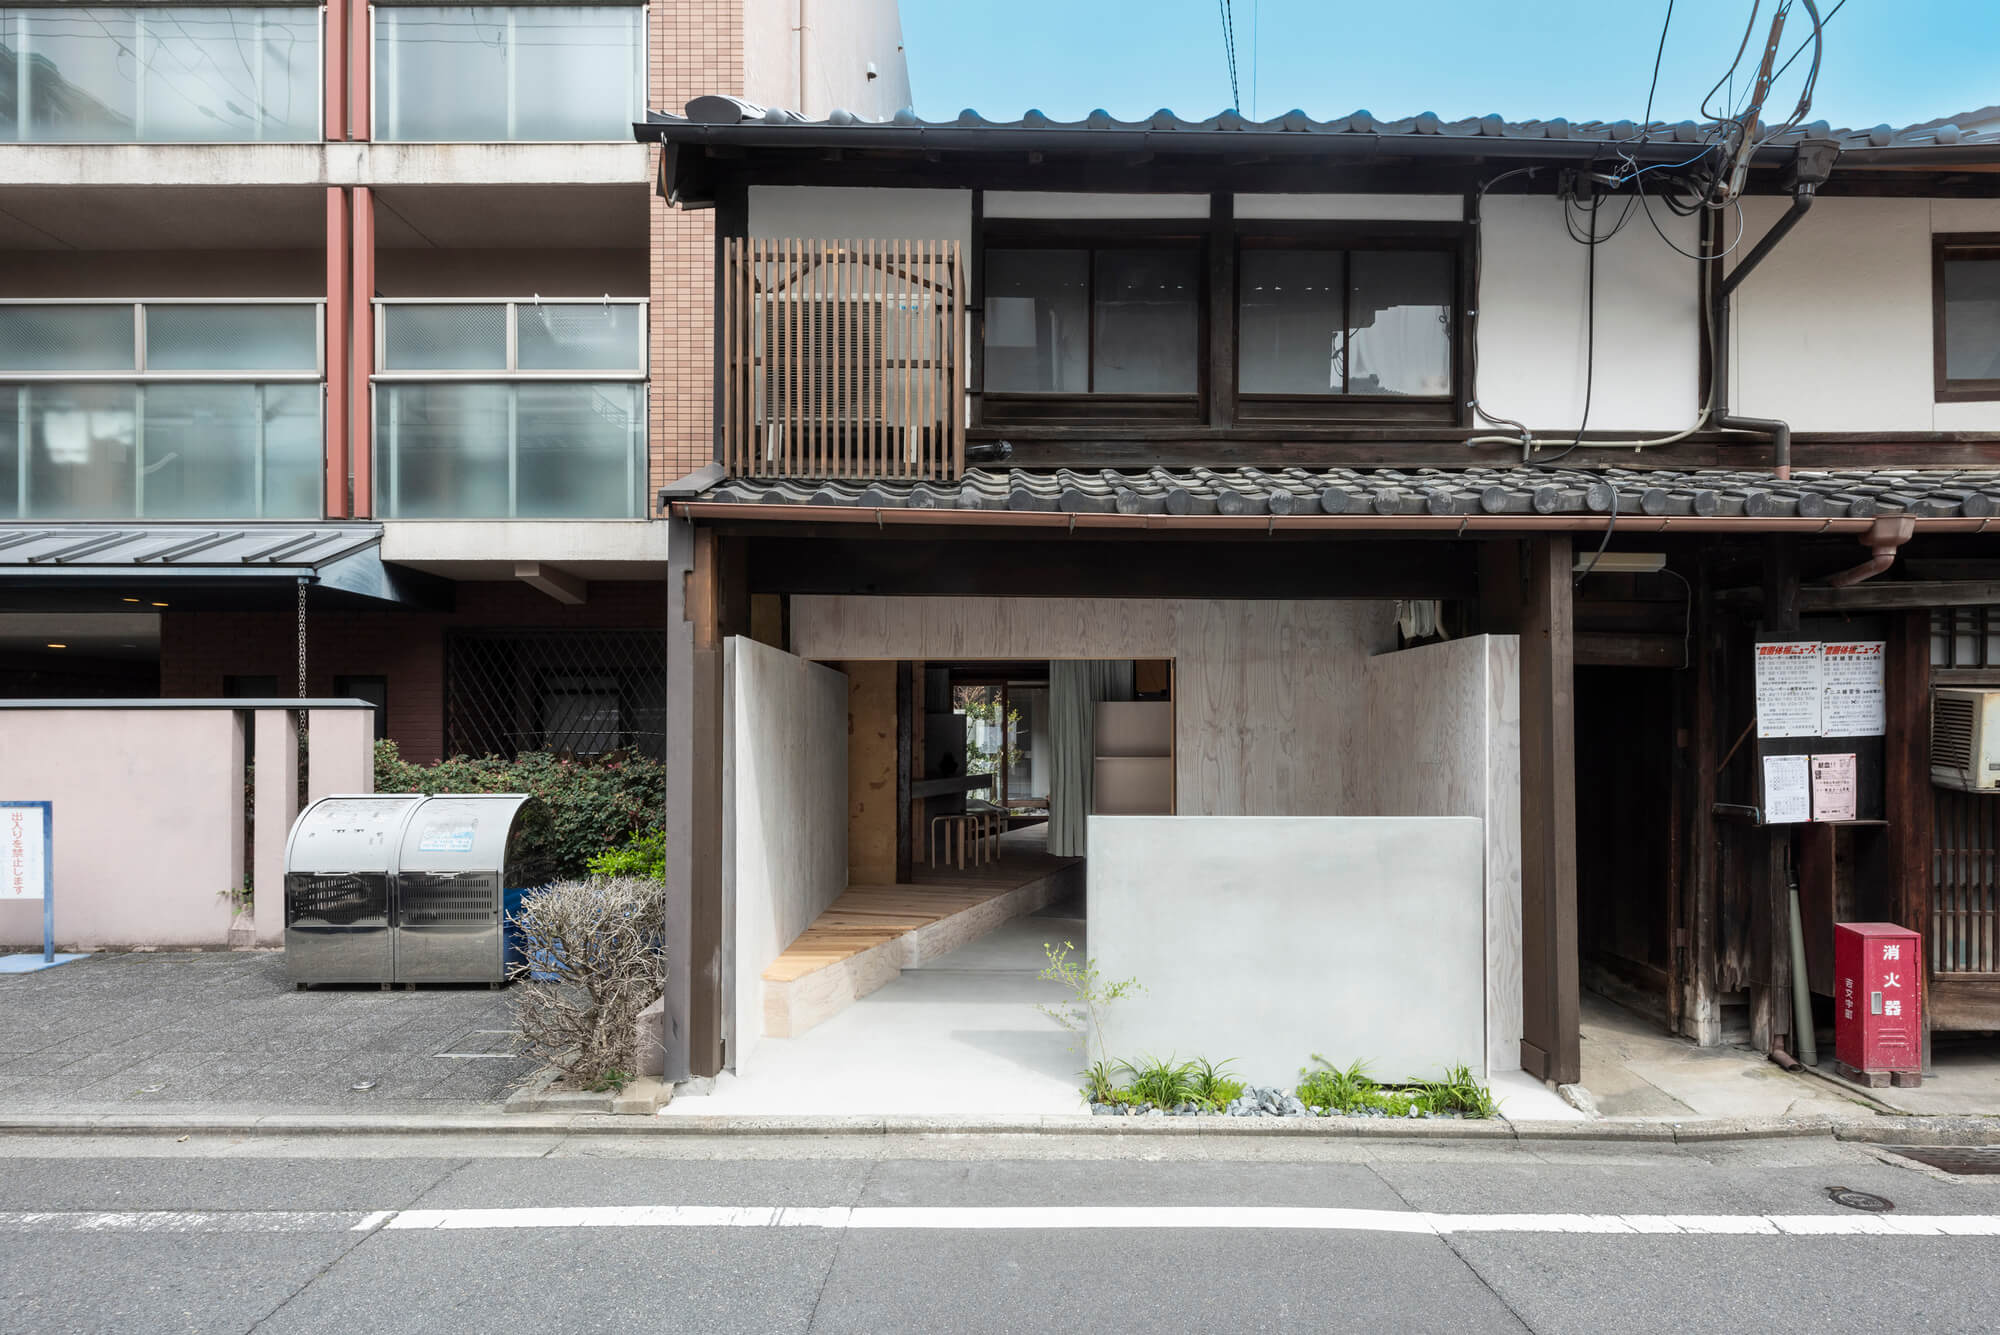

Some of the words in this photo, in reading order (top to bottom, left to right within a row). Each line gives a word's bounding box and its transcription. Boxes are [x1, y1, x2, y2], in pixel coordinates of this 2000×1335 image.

[11, 812, 24, 895] 出入りを禁止します
[1883, 944, 1902, 1016] 消火器
